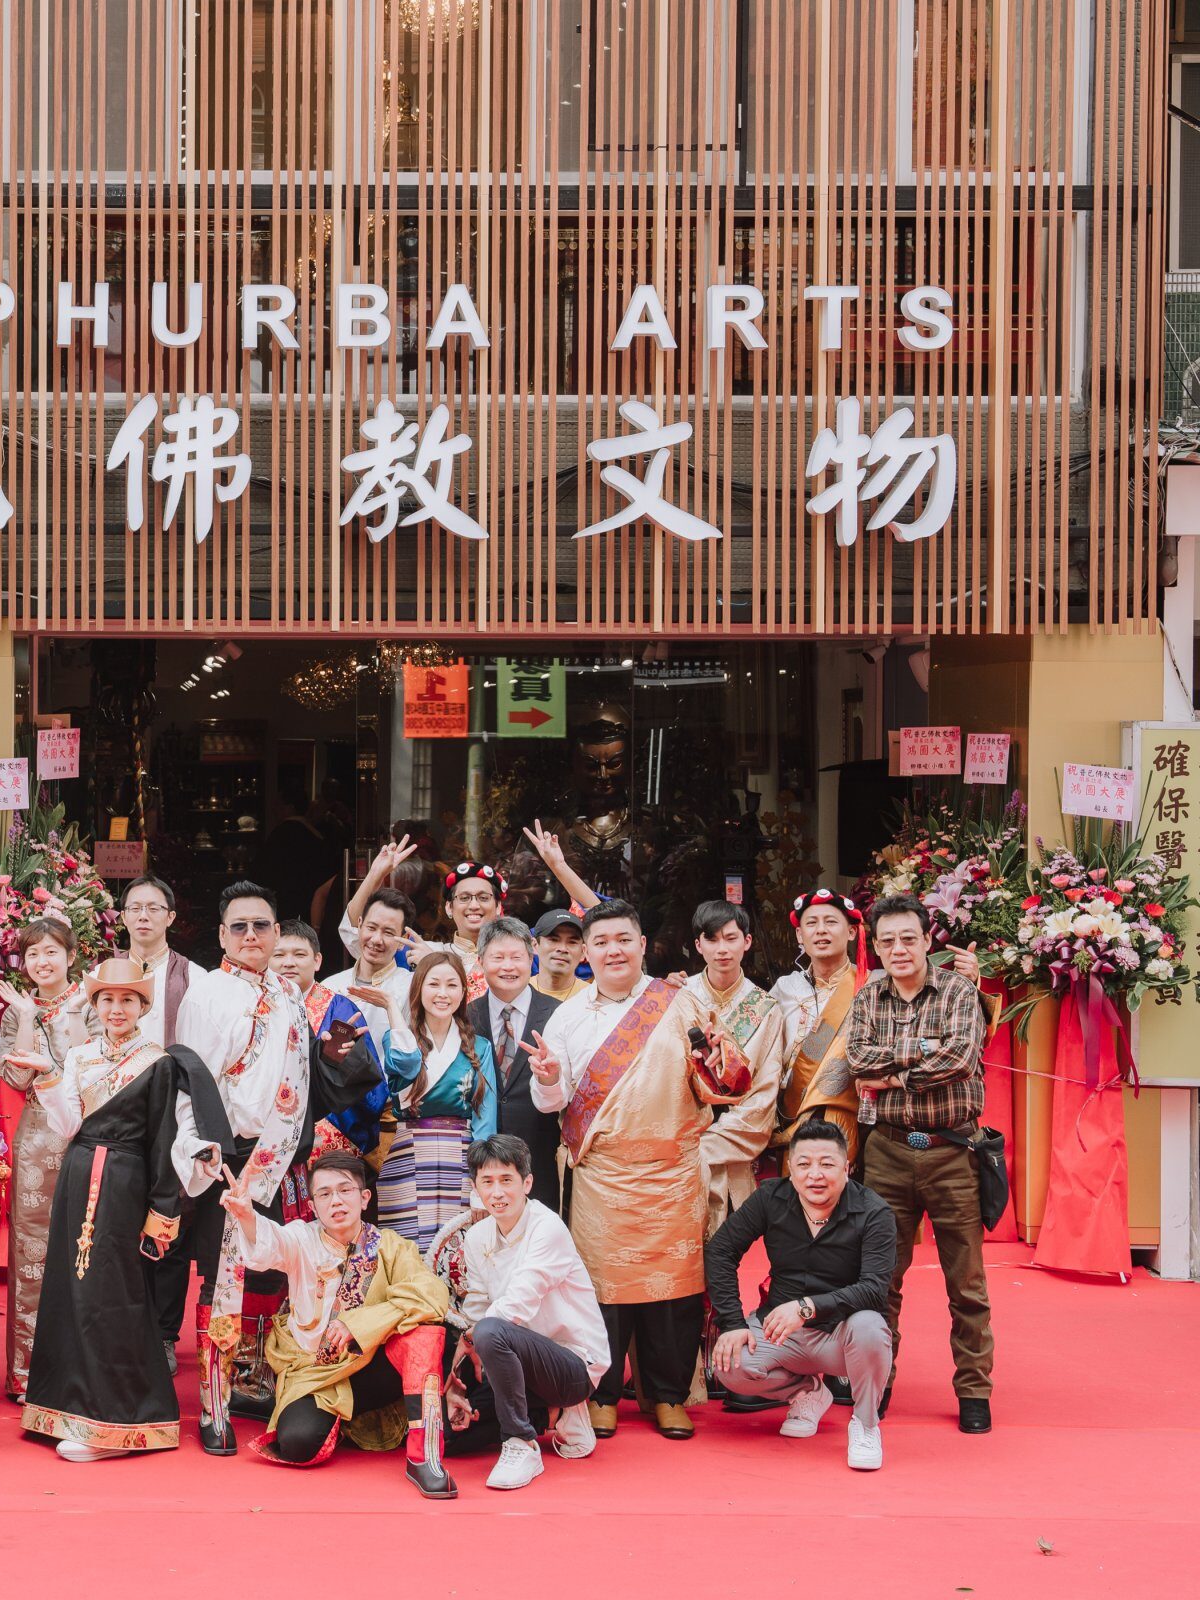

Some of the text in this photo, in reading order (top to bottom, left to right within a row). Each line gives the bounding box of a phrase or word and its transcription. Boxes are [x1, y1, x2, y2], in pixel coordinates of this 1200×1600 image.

[611, 285, 954, 352] ARTS
[1071, 782, 1126, 800] 鴻圖大展
